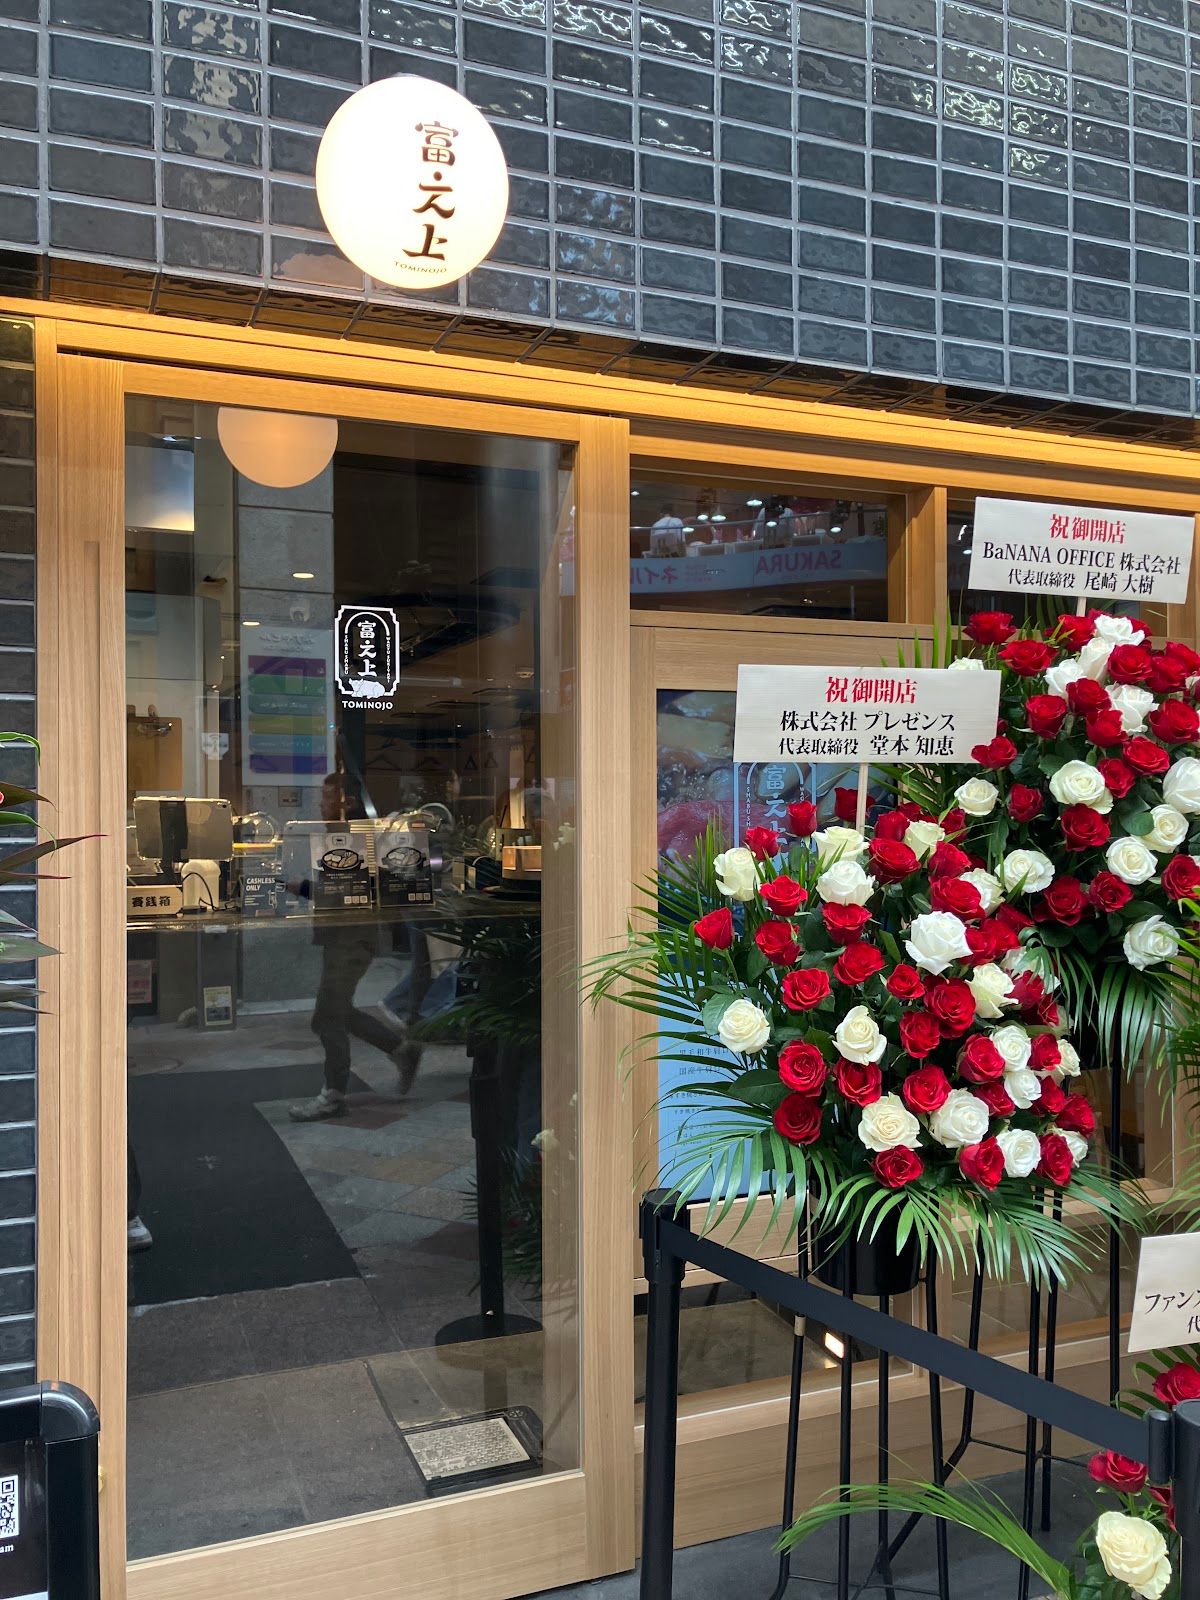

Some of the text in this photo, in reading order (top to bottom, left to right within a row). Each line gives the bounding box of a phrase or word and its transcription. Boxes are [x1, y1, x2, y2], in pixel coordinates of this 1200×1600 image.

[393, 261, 447, 274] TOMINOJO
[983, 541, 1181, 575] BaNANA OFFICE 株式会社
[1008, 568, 1076, 589] 代表取締役
[341, 700, 394, 711] TOMINOJO
[780, 710, 956, 732] 株式会社 プレゼンス
[779, 734, 955, 756] 代表取締役 堂本 知恵
[245, 884, 261, 892] ONLY
[246, 877, 276, 885] CASHLESS
[1145, 1289, 1200, 1315] ファン
